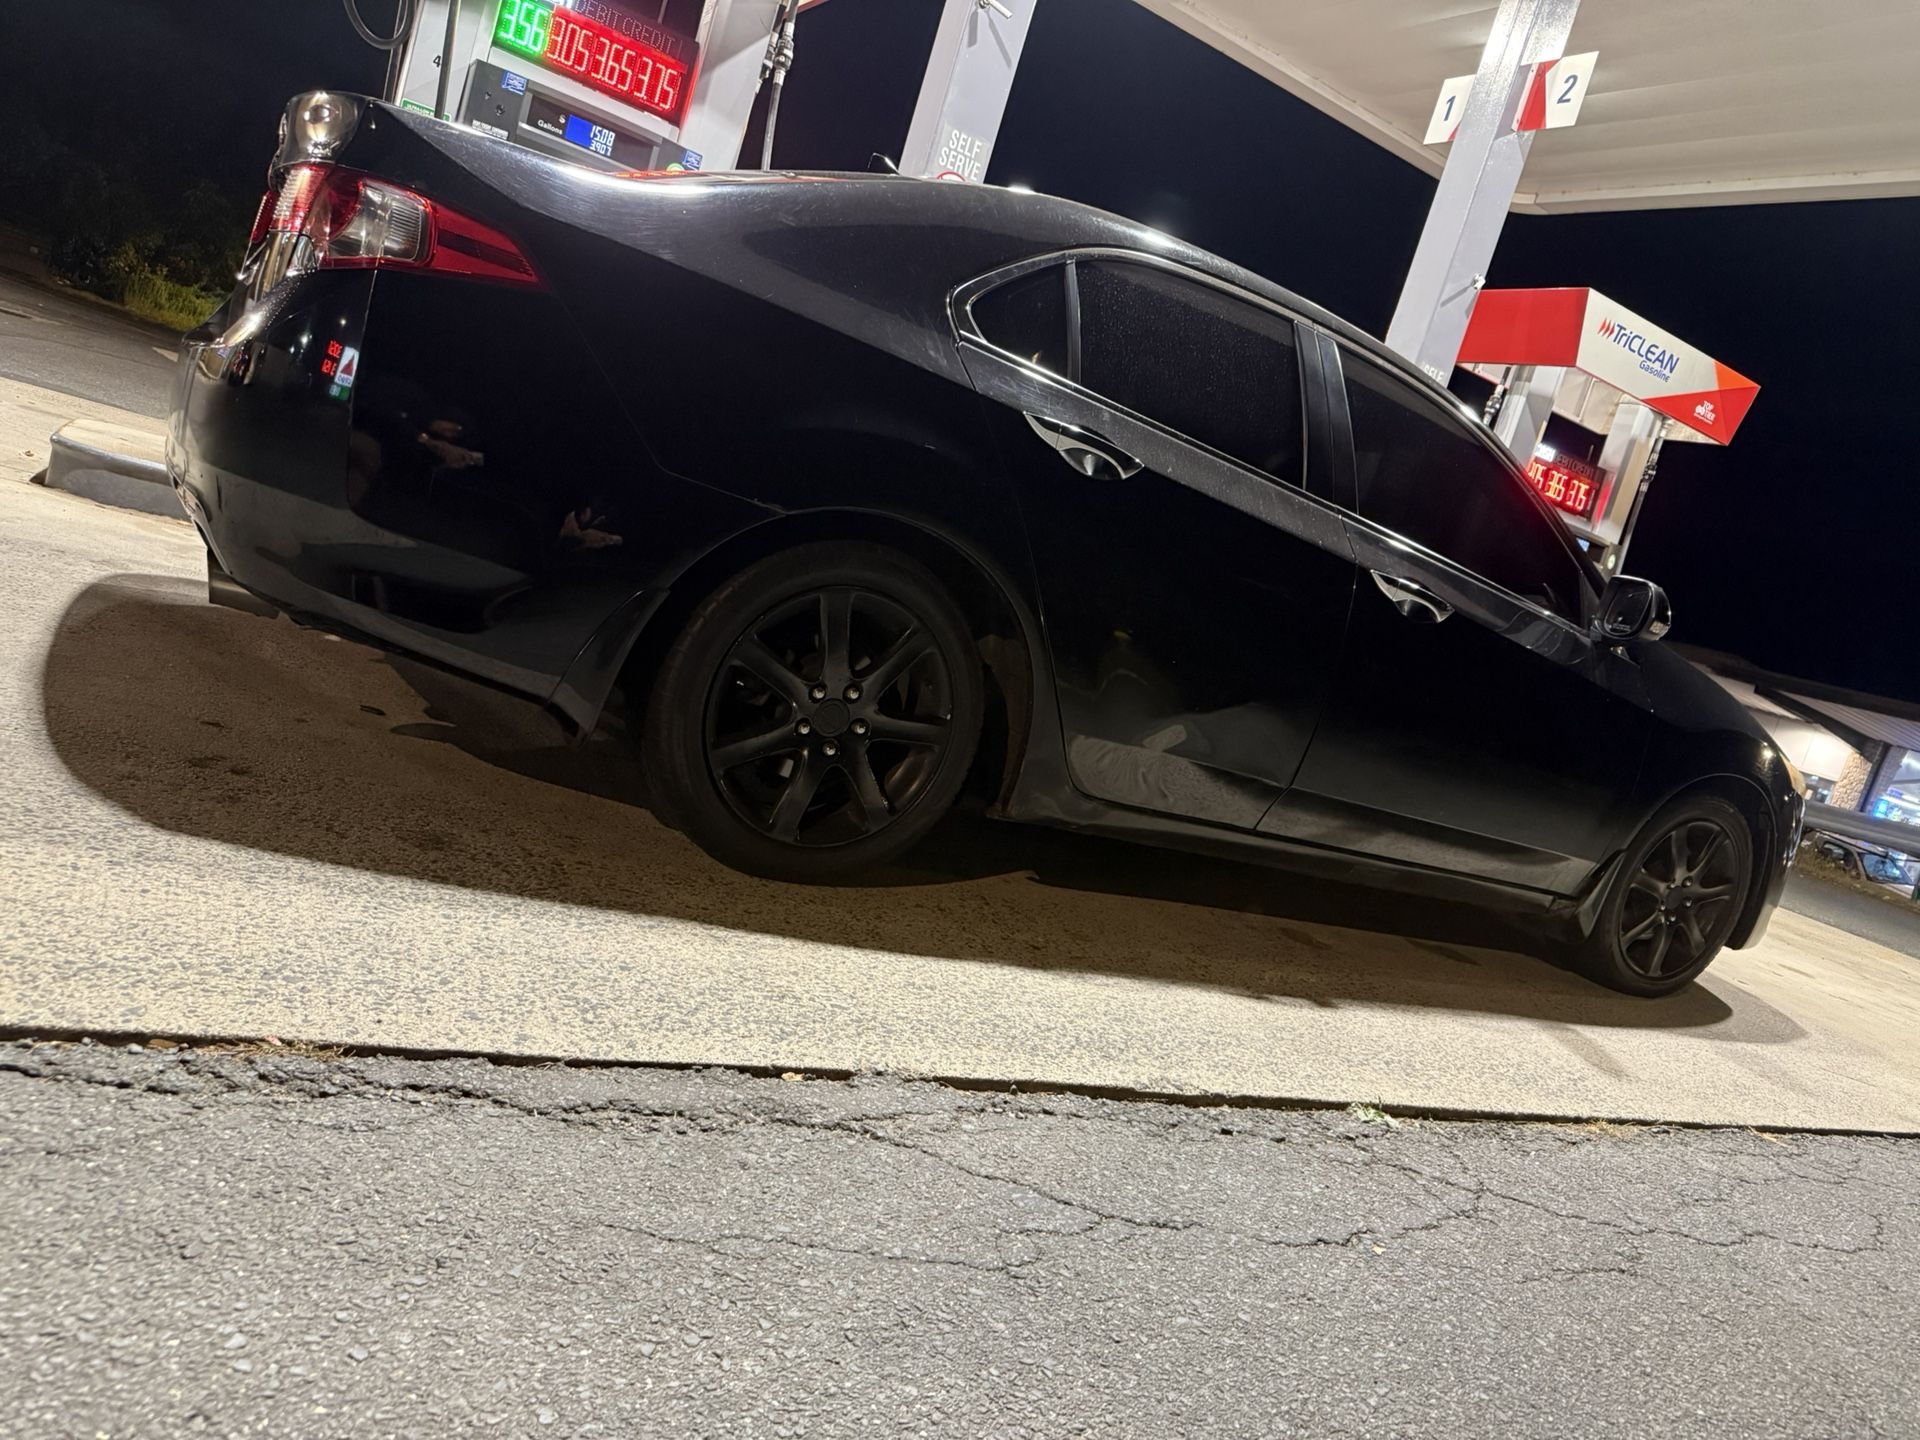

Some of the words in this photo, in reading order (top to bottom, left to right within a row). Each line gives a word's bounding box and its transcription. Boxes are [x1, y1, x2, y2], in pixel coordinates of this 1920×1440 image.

[574, 0, 622, 29] DEBIT
[622, 17, 676, 54] CREDIT
[432, 54, 442, 68] 4
[498, 0, 550, 52] 3.56
[546, 16, 593, 72] 3.05
[591, 36, 636, 92] 3.65
[634, 57, 678, 110] 3.75
[1556, 74, 1578, 105] 2
[1443, 95, 1456, 122] 1
[537, 119, 563, 135] Gallons
[949, 129, 982, 159] SELF
[939, 146, 982, 181] SERVE
[1612, 322, 1680, 374] TriCLEAN
[1638, 359, 1671, 383] Gasoline
